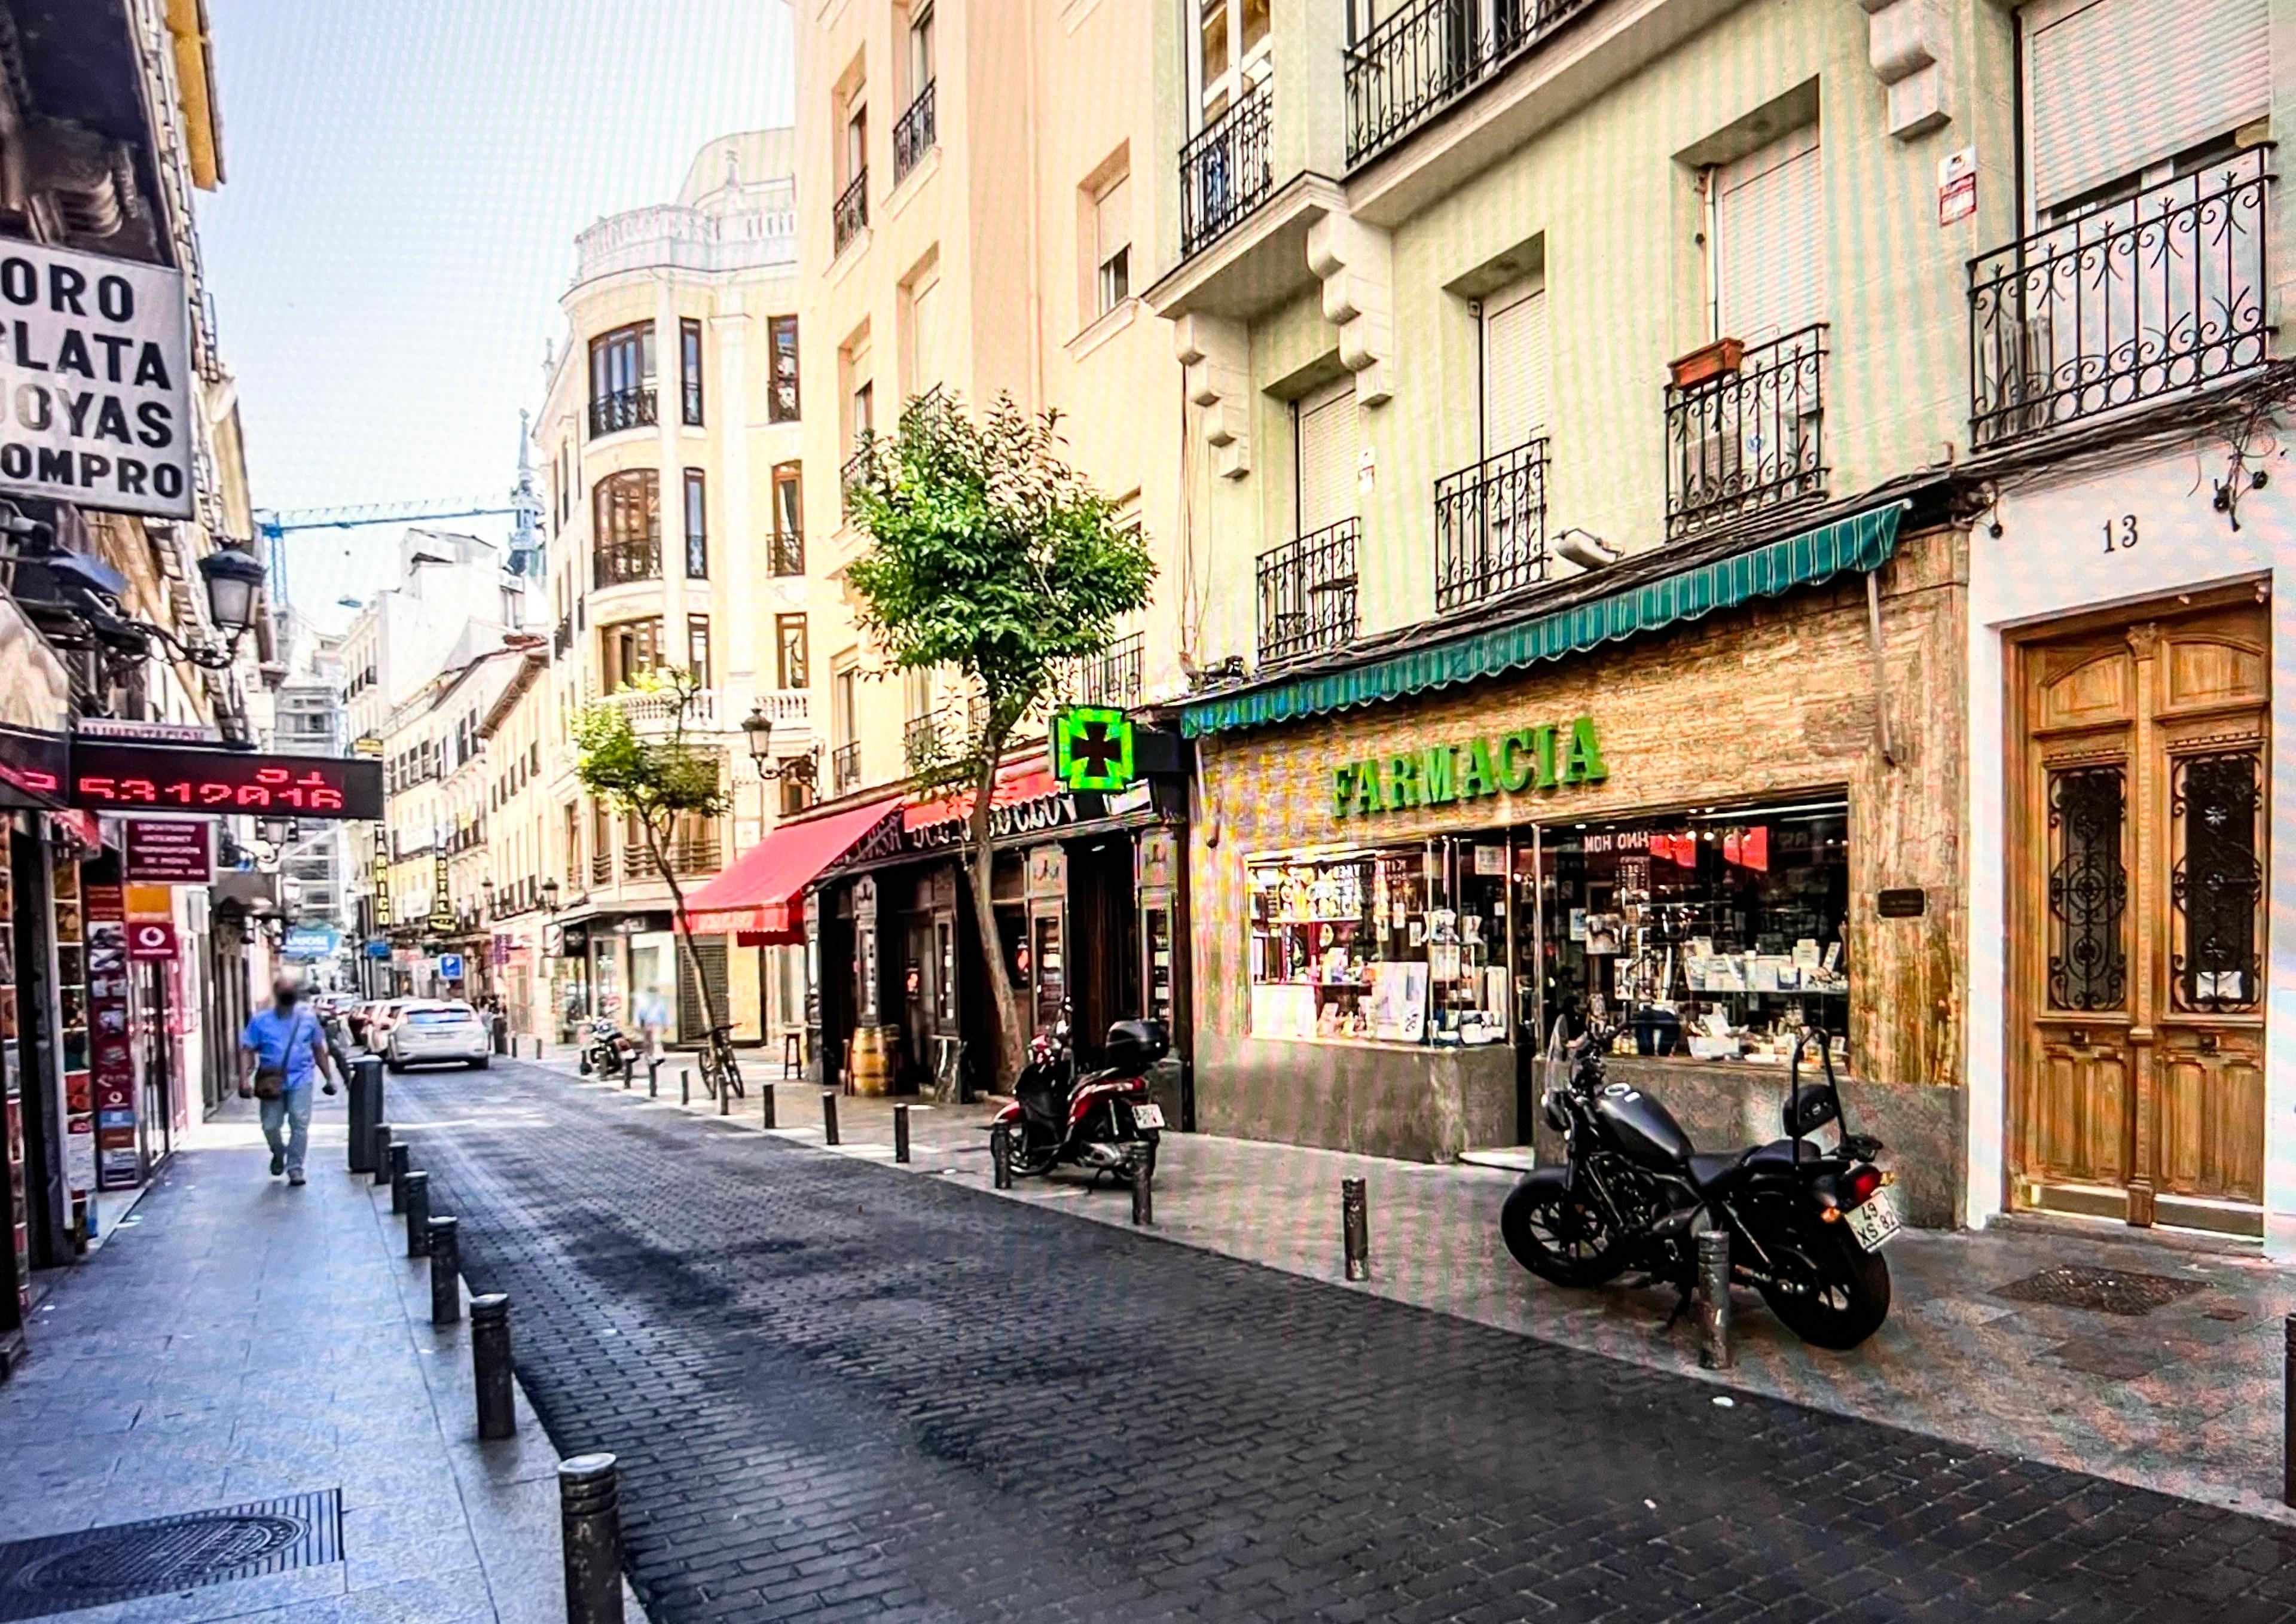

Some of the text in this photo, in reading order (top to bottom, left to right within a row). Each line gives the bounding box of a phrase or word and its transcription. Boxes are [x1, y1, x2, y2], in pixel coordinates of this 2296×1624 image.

[1, 257, 134, 323] ORO
[0, 319, 172, 390] LATA
[0, 378, 173, 448] OYAS
[2103, 514, 2138, 554] 13
[1333, 716, 1608, 819] FARMACIA
